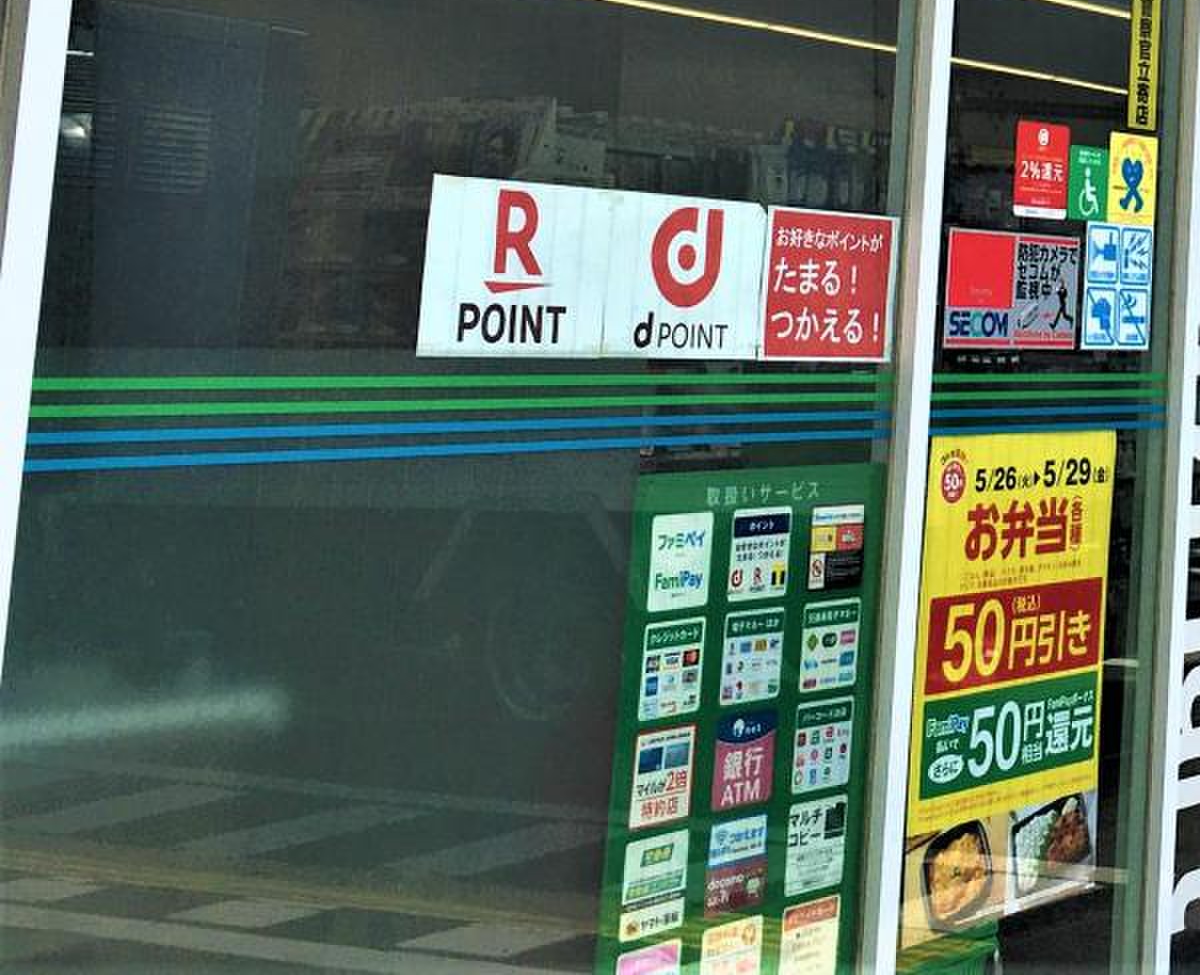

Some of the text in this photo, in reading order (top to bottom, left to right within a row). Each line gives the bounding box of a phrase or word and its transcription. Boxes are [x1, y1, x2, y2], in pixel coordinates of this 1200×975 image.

[493, 188, 543, 276] R
[777, 226, 883, 252] お好きなポイントが
[1017, 242, 1078, 264] 防犯カメラで
[774, 256, 858, 295] たまる!
[1016, 262, 1061, 282] セコムが
[1016, 280, 1052, 300] 監視中
[456, 303, 567, 344] POINT
[633, 312, 728, 349] d POINT
[771, 307, 879, 344] つかえる!
[948, 311, 1009, 337] SECOM
[706, 482, 820, 506] 取扱いサービス
[657, 528, 707, 551] ファミペイ
[964, 496, 1069, 561] お弁当
[655, 569, 703, 591] FamiPay
[942, 598, 1092, 683] 50円引き
[967, 700, 1045, 778] 50円
[1045, 705, 1094, 755] 還元
[723, 747, 764, 782] 銀行
[719, 778, 761, 807] ATM
[789, 808, 824, 828] マルチ
[788, 827, 823, 848] コピー
